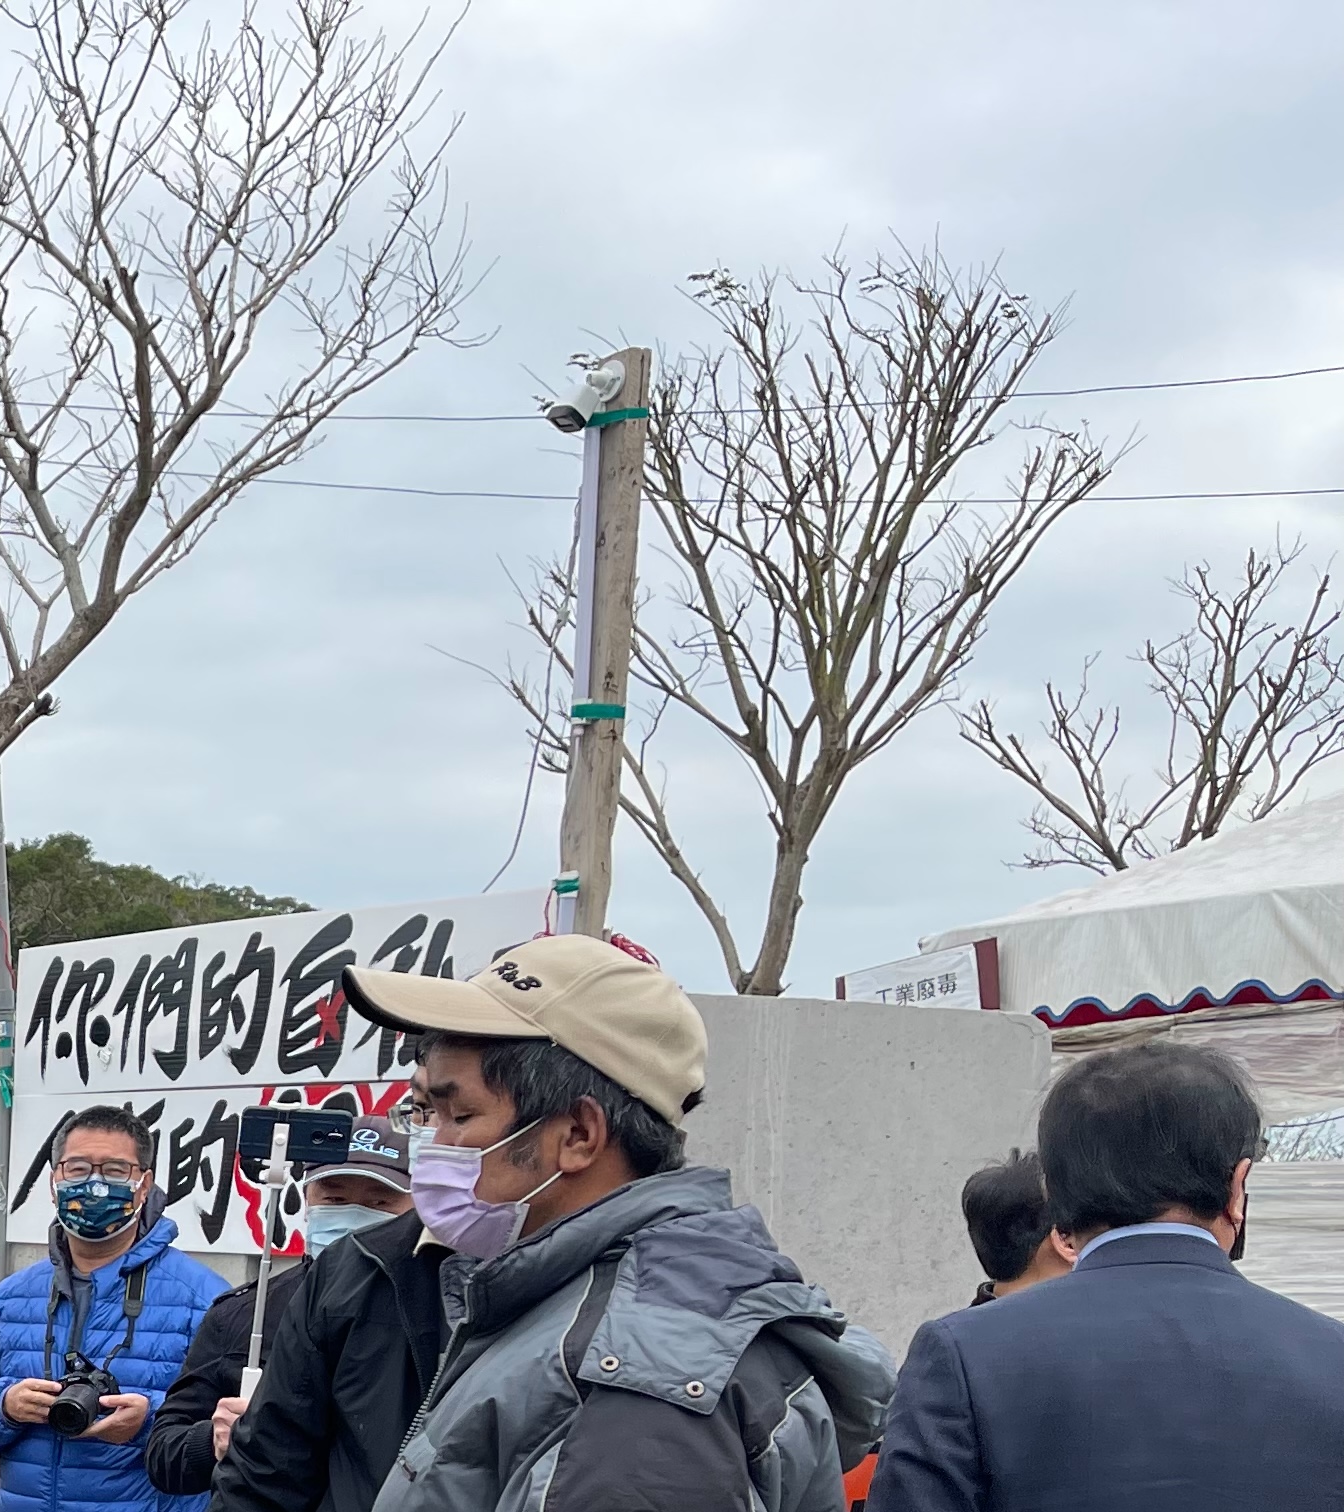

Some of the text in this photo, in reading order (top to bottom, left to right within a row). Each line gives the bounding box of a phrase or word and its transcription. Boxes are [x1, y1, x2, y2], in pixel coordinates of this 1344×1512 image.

[24, 912, 534, 1088] 你們的自私
[349, 1142, 400, 1159] EXUS
